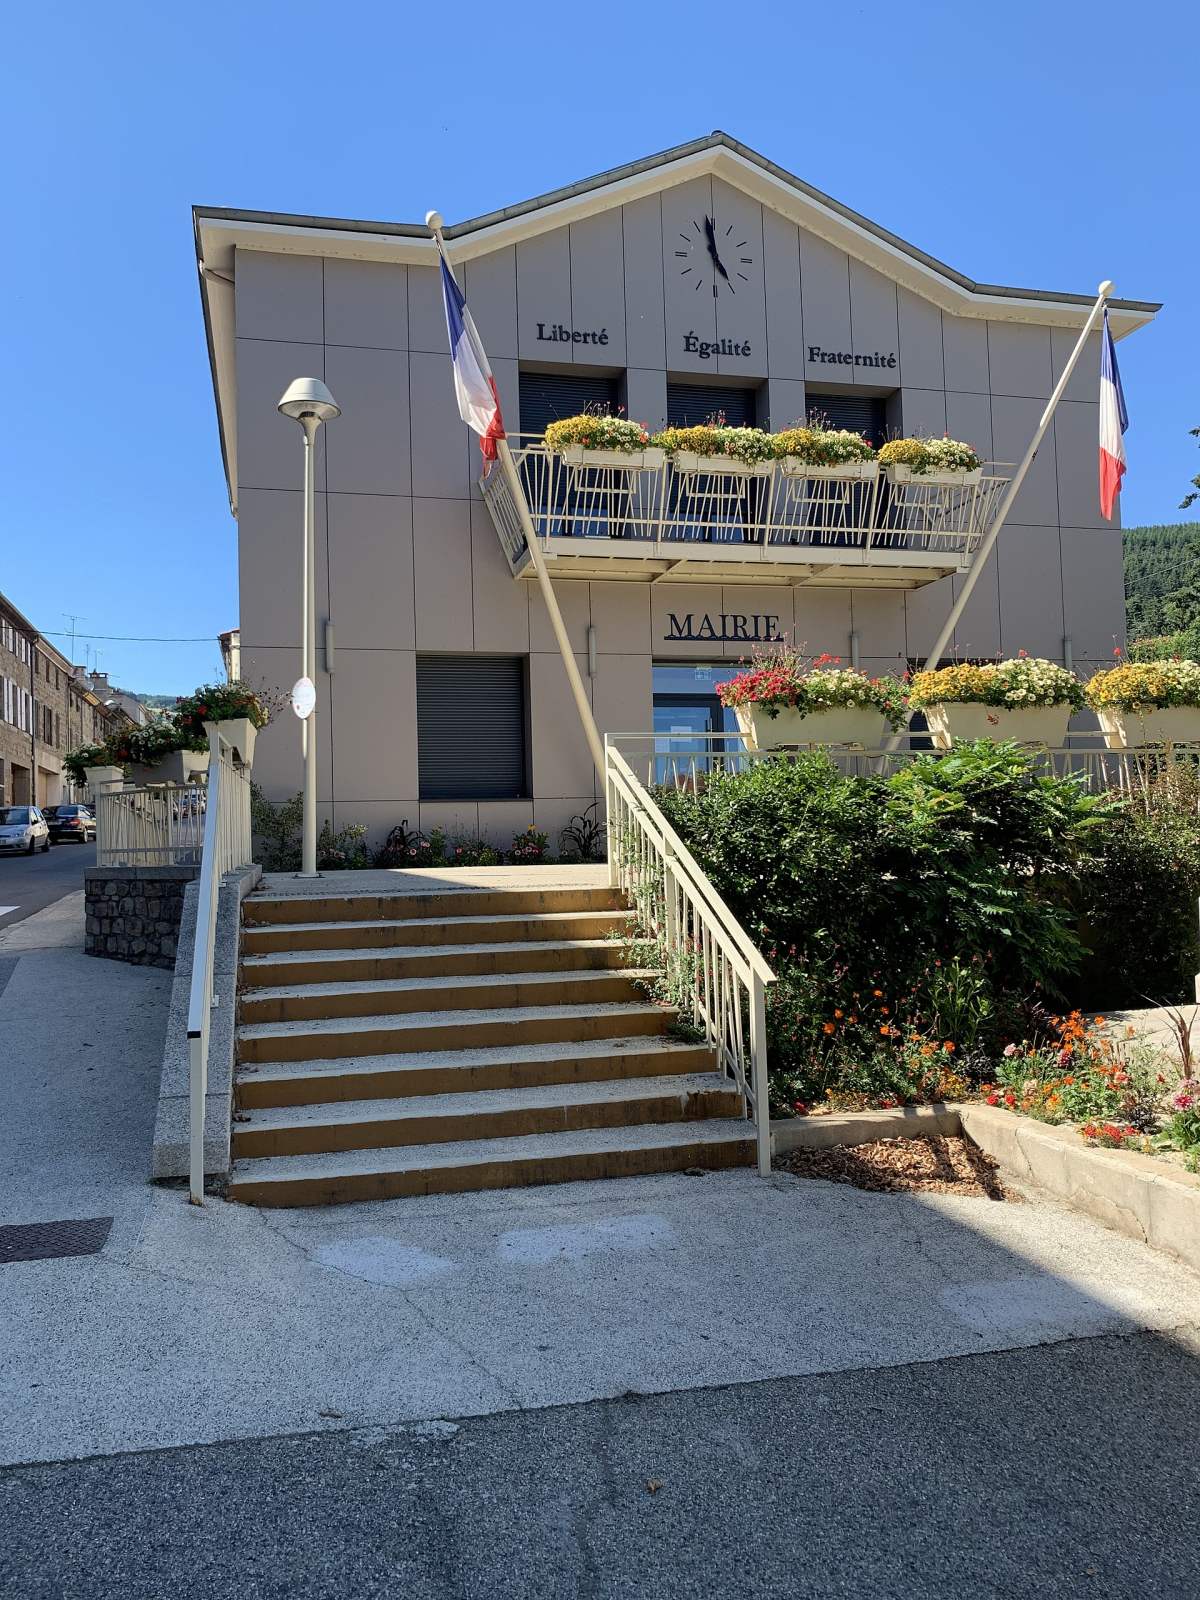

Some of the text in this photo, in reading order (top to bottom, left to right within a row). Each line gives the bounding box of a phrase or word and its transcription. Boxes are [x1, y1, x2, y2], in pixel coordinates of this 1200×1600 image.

[536, 323, 609, 346] Liberté
[683, 330, 752, 359] Égalité
[807, 346, 897, 370] Fraternité
[666, 613, 782, 640] MAIRIE
